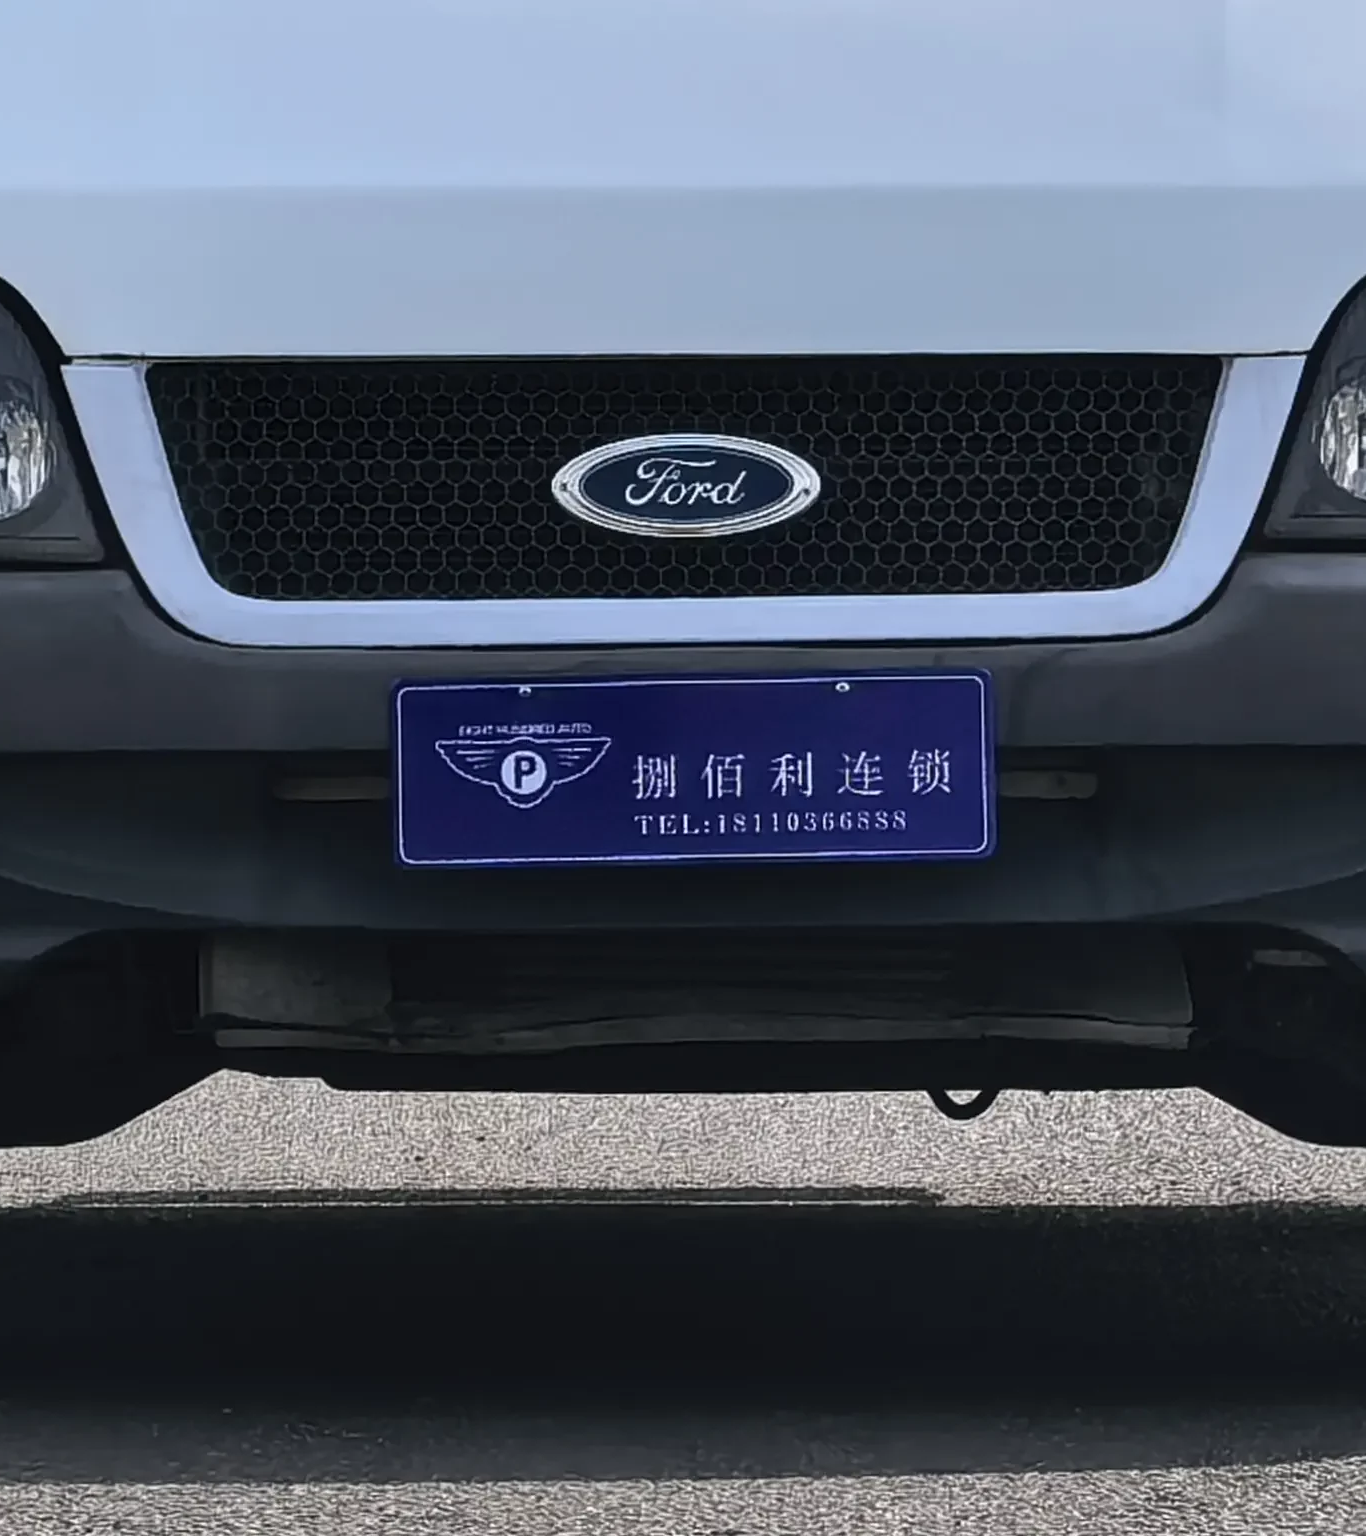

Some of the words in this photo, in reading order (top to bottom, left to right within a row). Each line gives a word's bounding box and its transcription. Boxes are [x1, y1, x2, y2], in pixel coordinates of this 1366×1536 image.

[625, 458, 746, 505] Ford
[513, 754, 537, 789] P
[632, 748, 951, 800] 捌佰利连锁
[634, 810, 908, 835] TEL:18110366888
